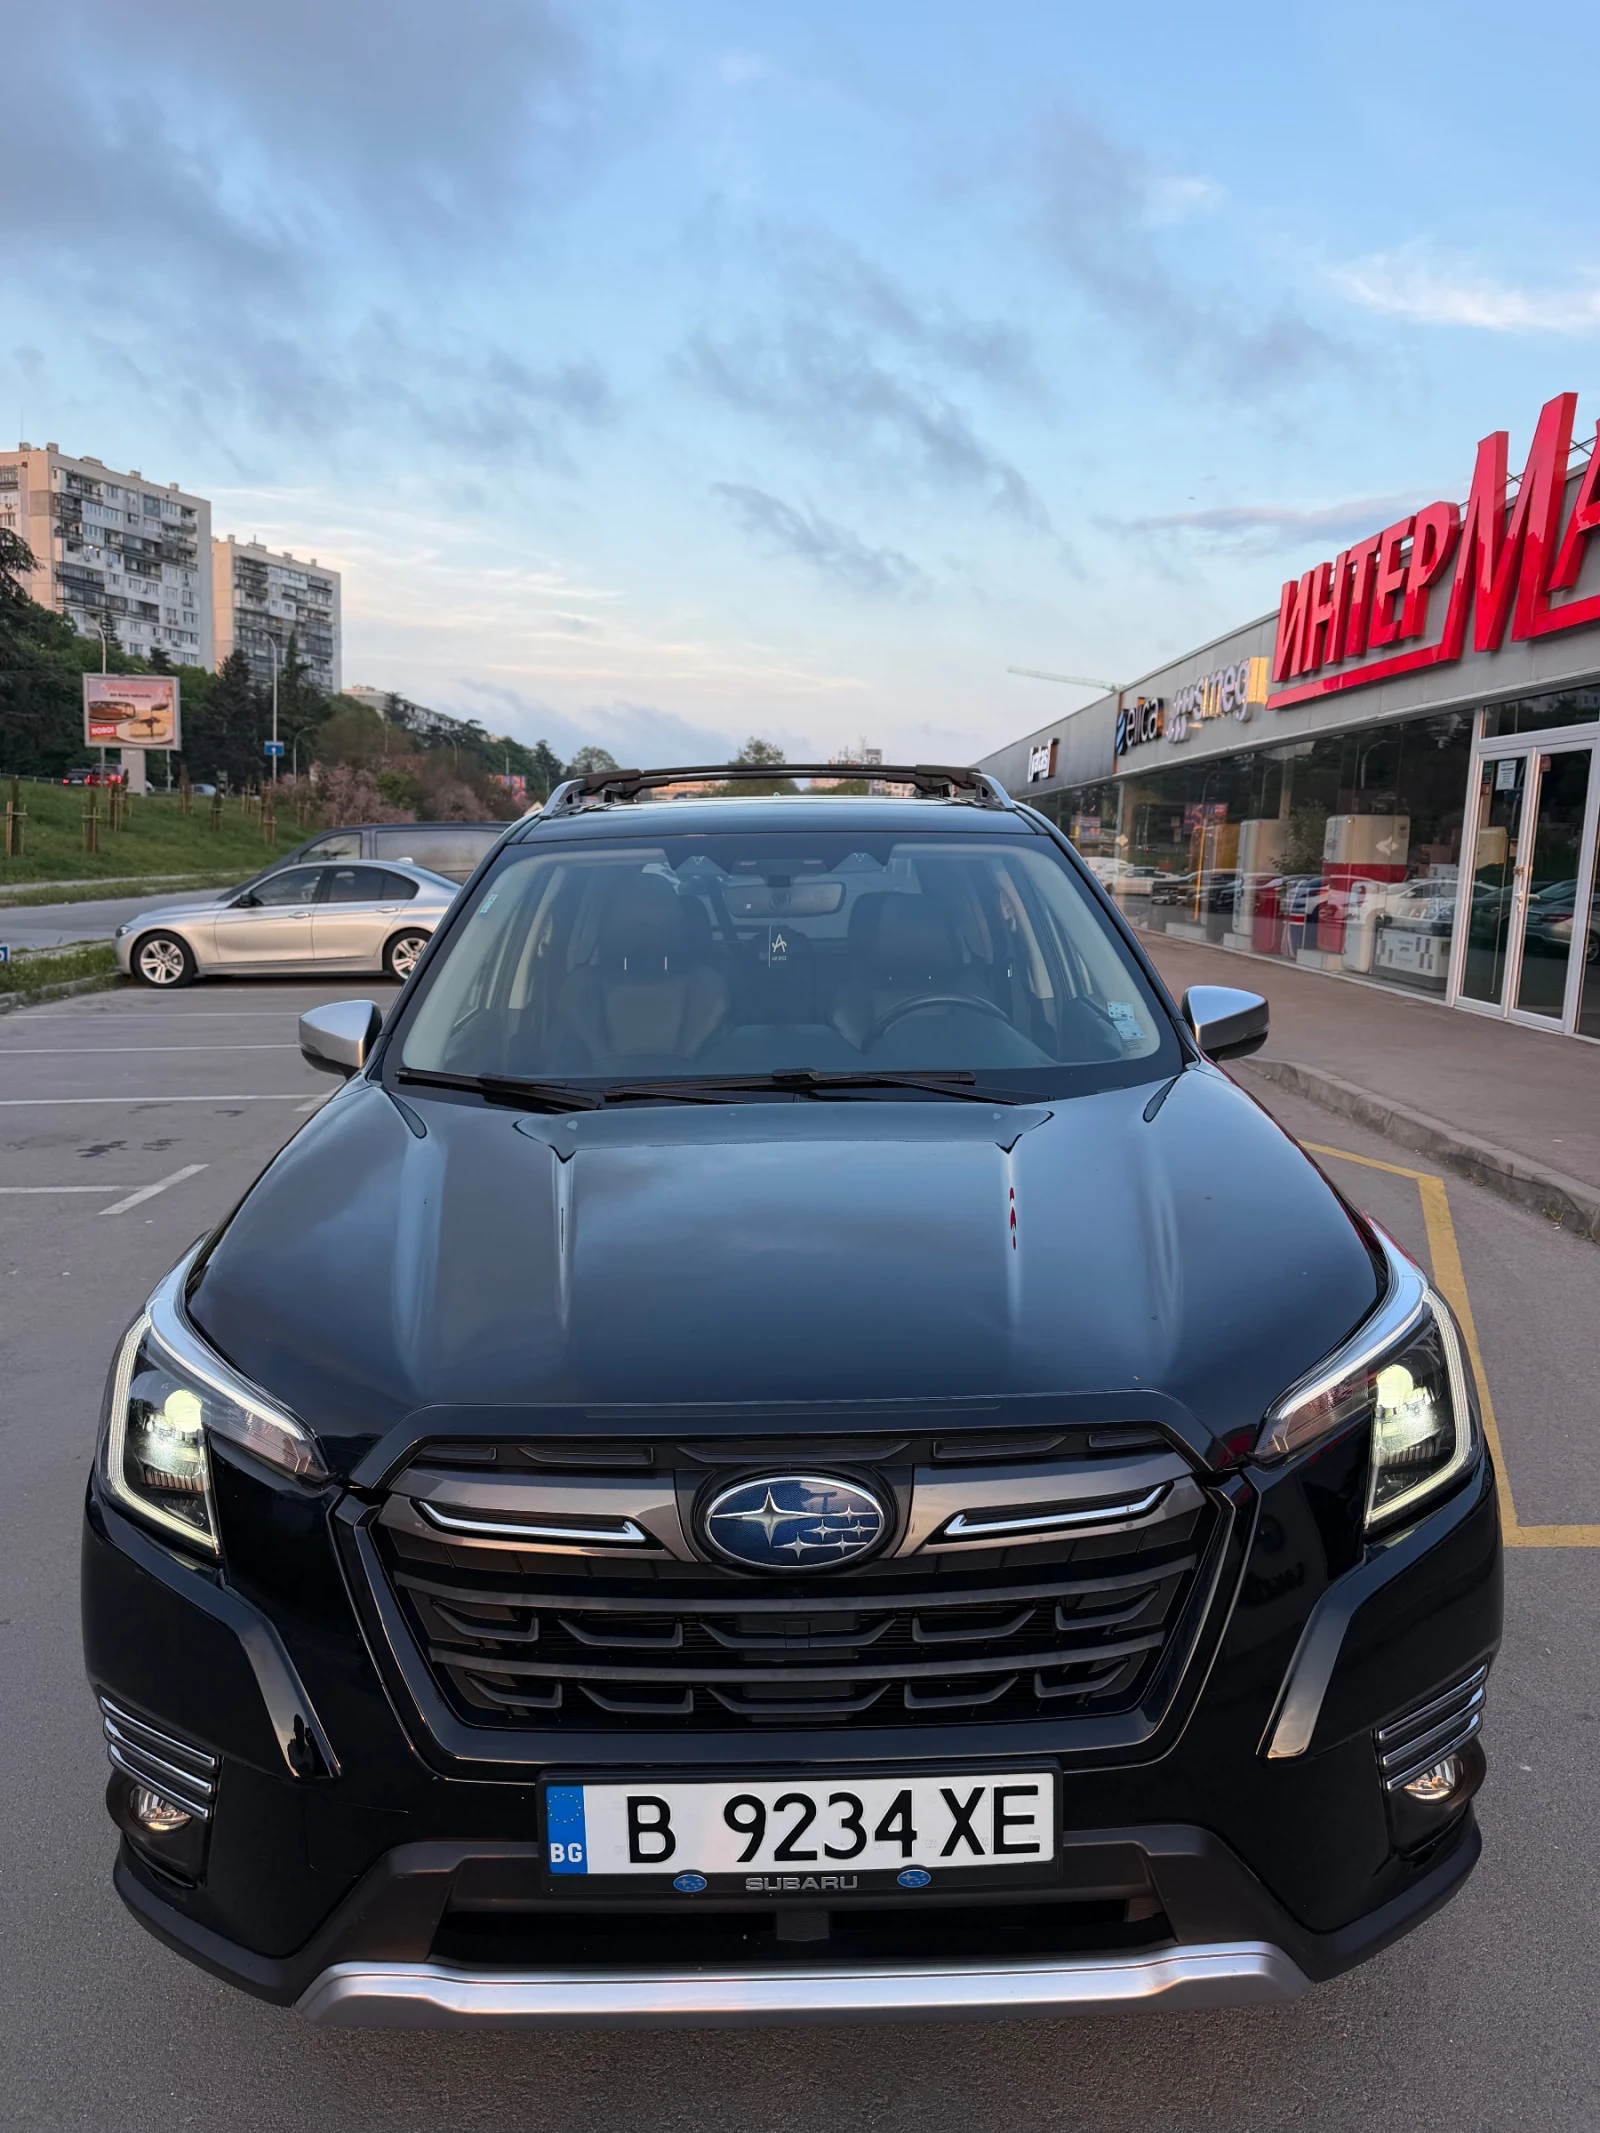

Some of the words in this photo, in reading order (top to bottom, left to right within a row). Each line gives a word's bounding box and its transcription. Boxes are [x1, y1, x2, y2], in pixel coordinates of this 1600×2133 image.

[1193, 658, 1251, 722] smeg
[1125, 698, 1159, 747] elica
[626, 1795, 676, 1863] B
[723, 1789, 918, 1863] 9234
[939, 1784, 1040, 1857] XE
[550, 1842, 583, 1863] BG
[745, 1875, 858, 1892] SUBARU
